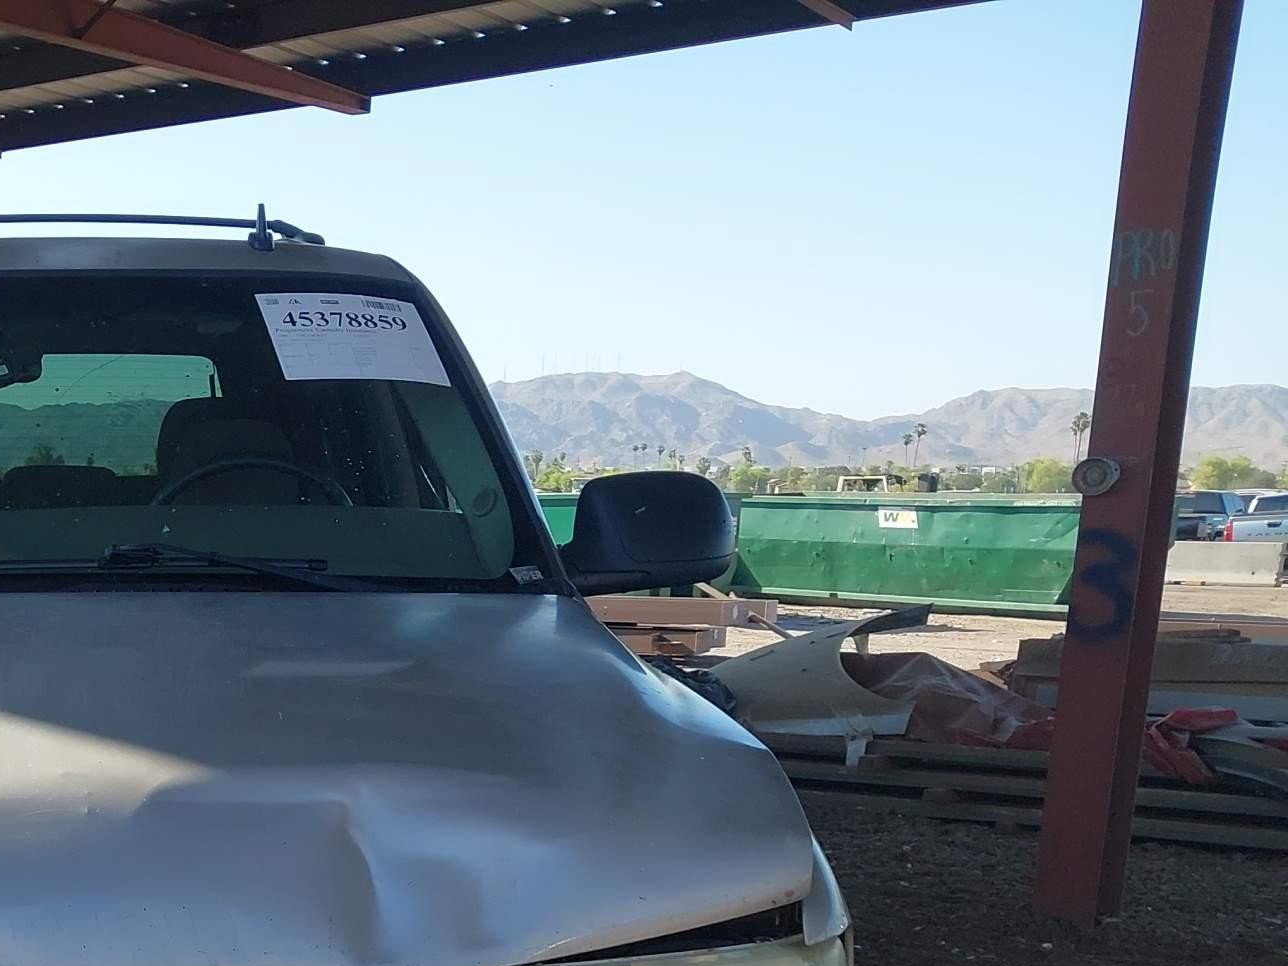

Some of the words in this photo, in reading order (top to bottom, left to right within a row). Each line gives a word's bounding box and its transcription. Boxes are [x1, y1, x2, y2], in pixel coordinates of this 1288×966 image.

[282, 311, 407, 332] 45378859
[1126, 289, 1154, 337] 5
[1068, 527, 1137, 643] 3
